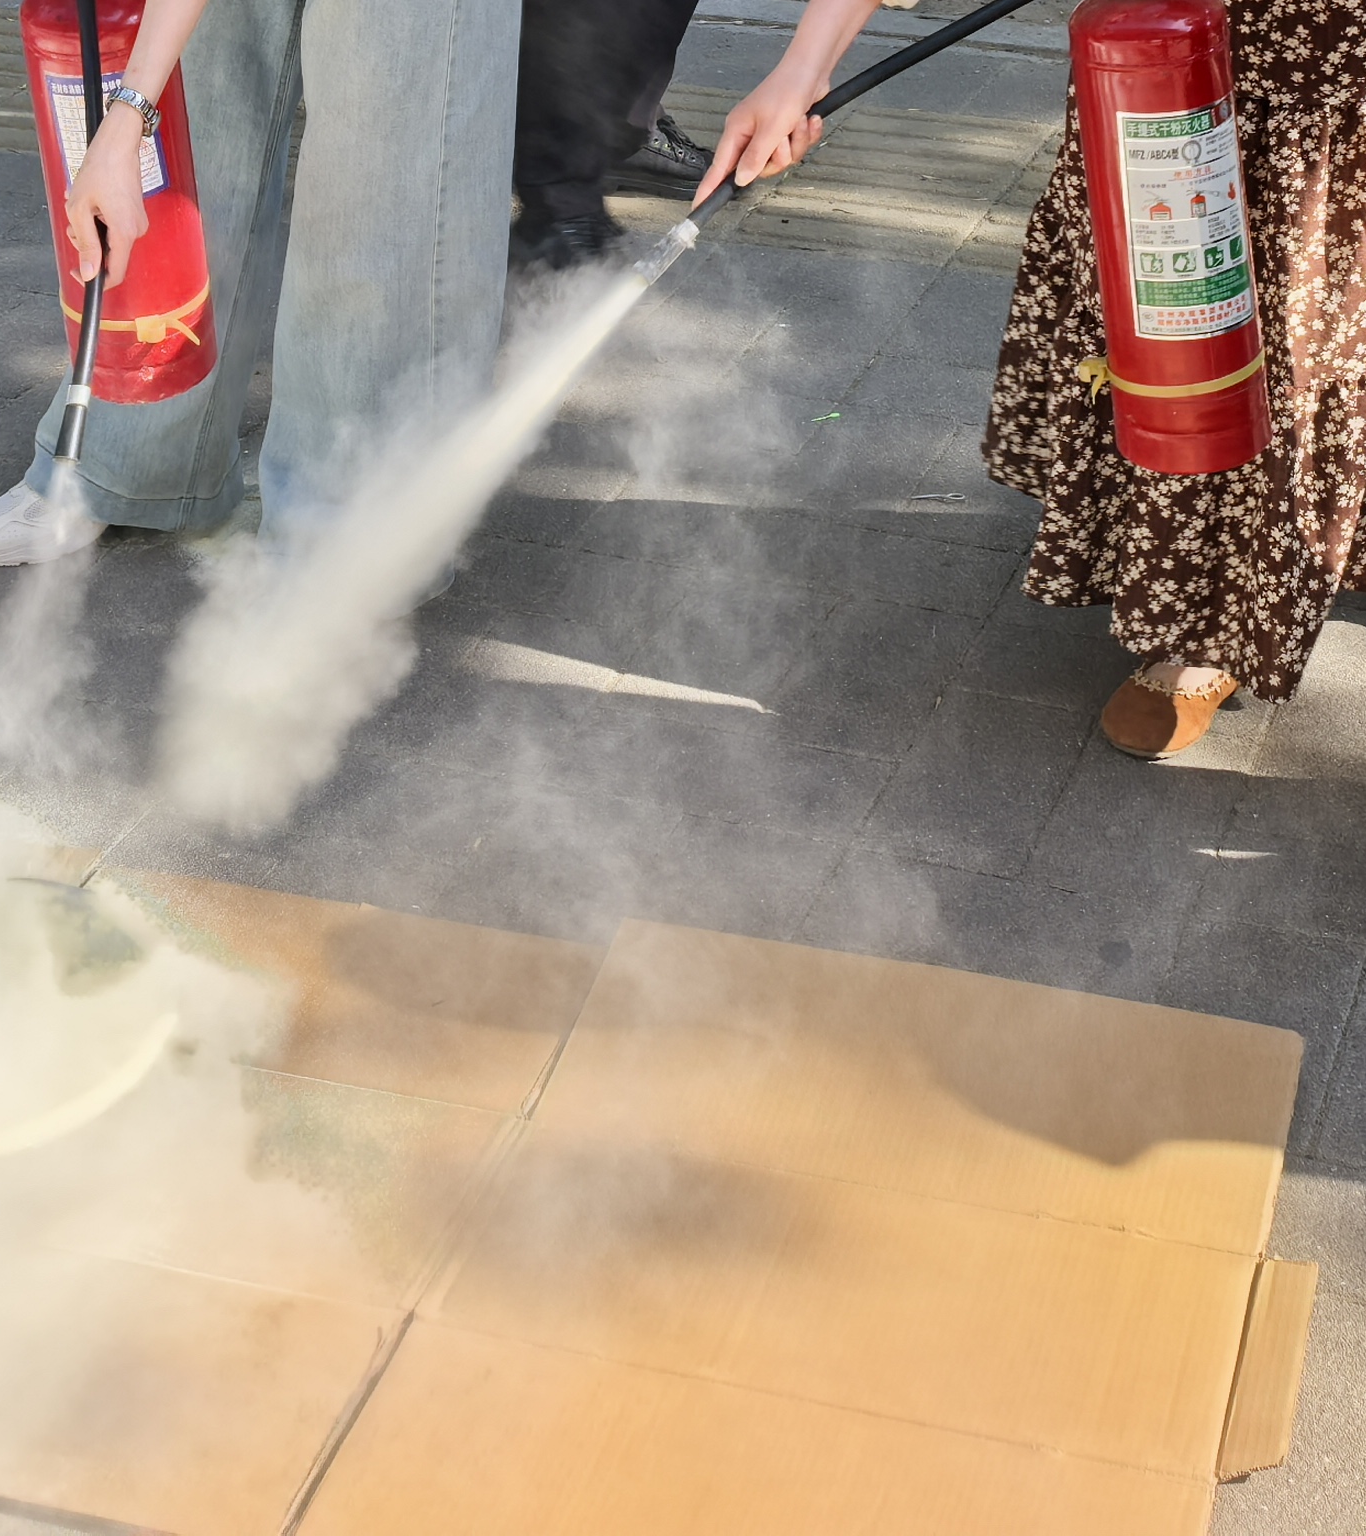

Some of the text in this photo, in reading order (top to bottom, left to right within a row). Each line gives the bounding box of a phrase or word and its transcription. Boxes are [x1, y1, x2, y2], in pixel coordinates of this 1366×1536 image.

[1127, 114, 1211, 137] 手提式干粉灭火器
